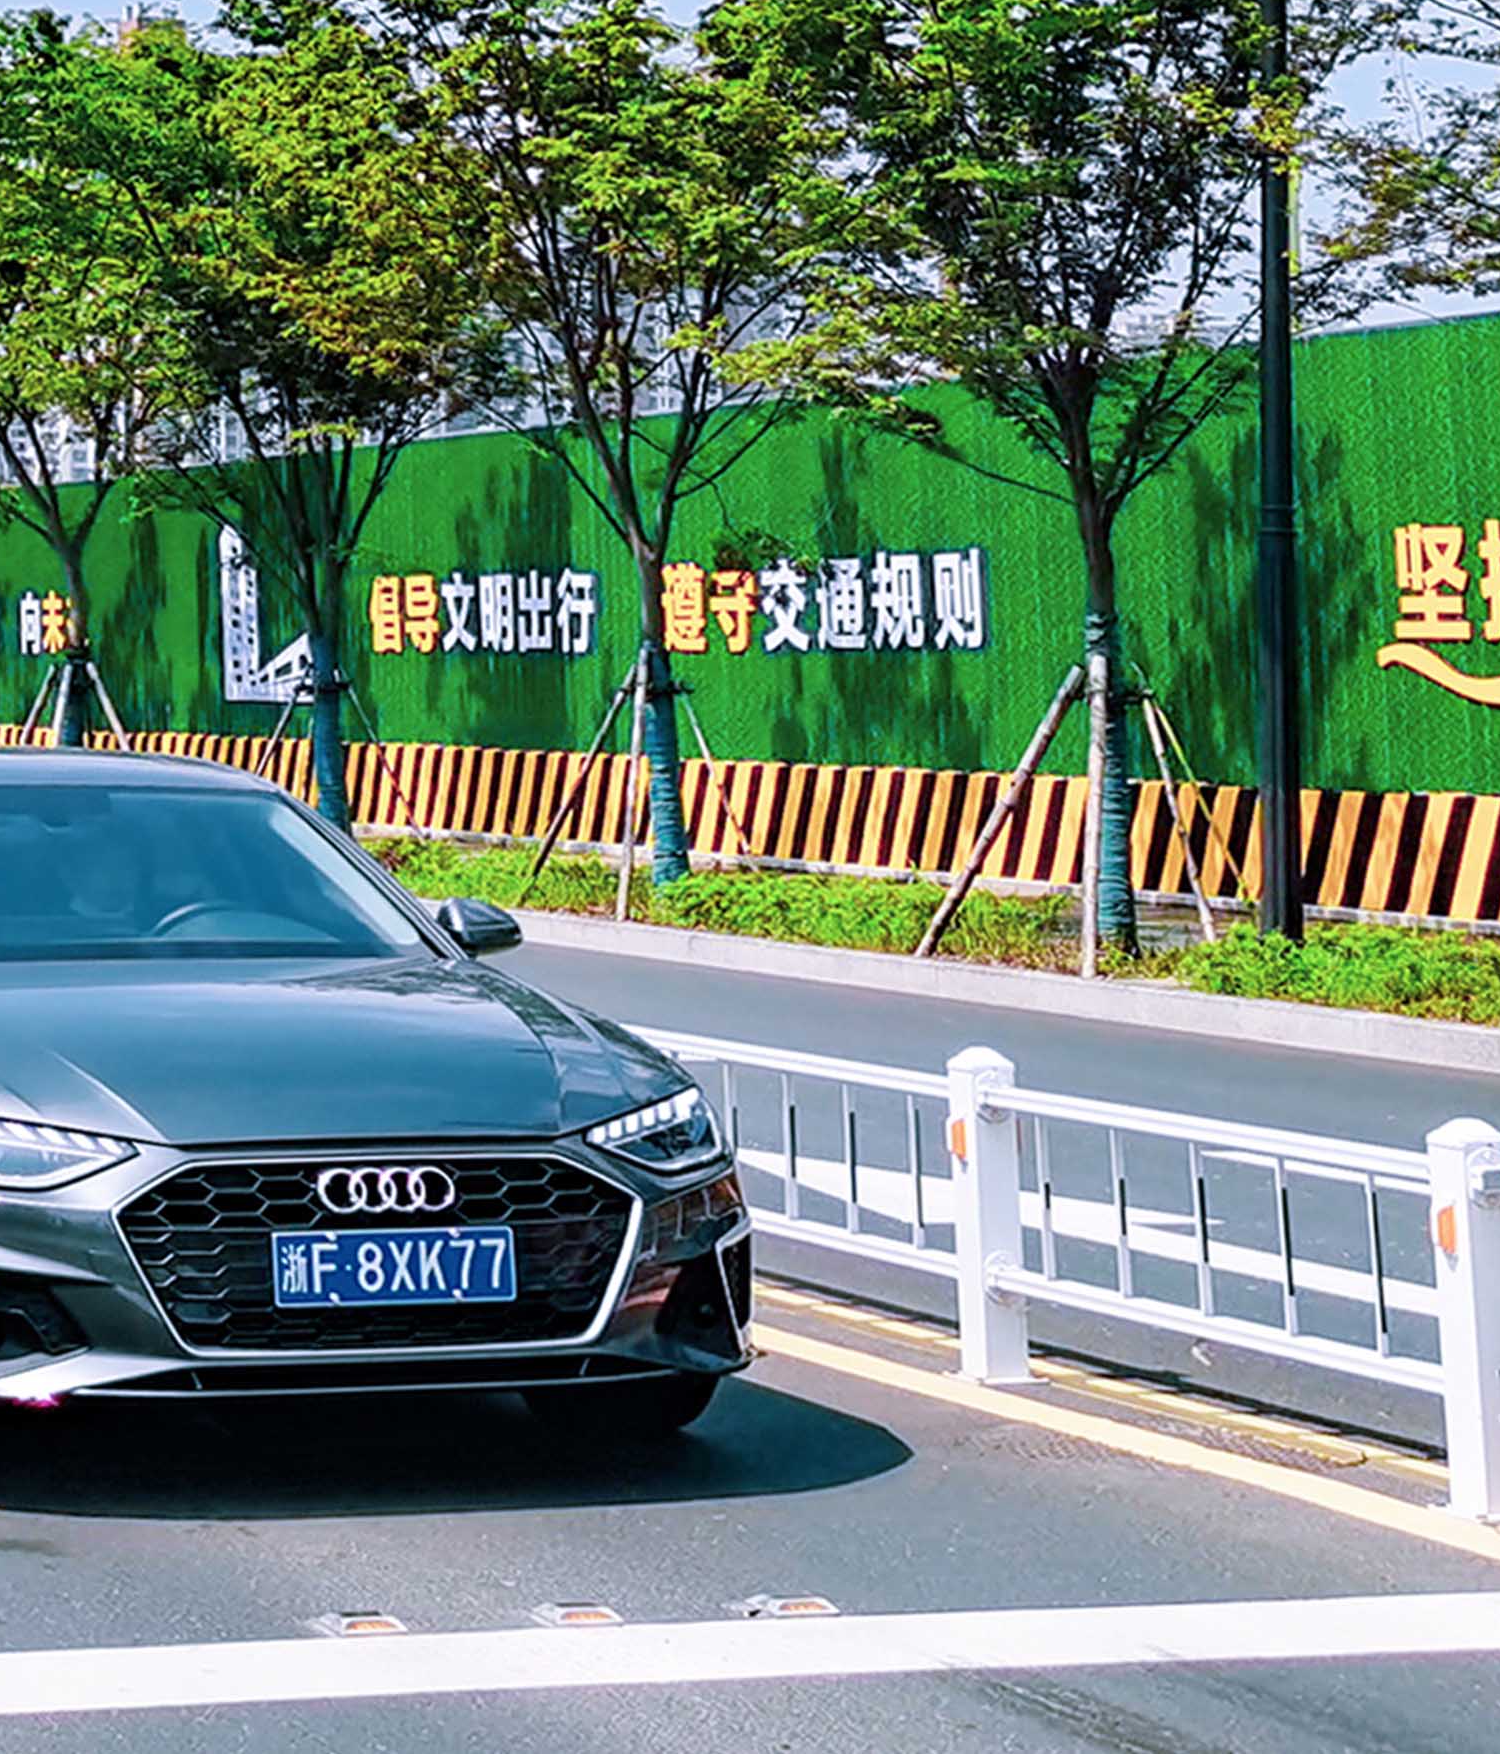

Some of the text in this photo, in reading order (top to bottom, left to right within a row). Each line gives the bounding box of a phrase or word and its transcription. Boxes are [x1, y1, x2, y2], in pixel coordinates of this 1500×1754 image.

[19, 589, 74, 655] 向未
[369, 547, 984, 654] 倡导文明出行 遵守交通规则
